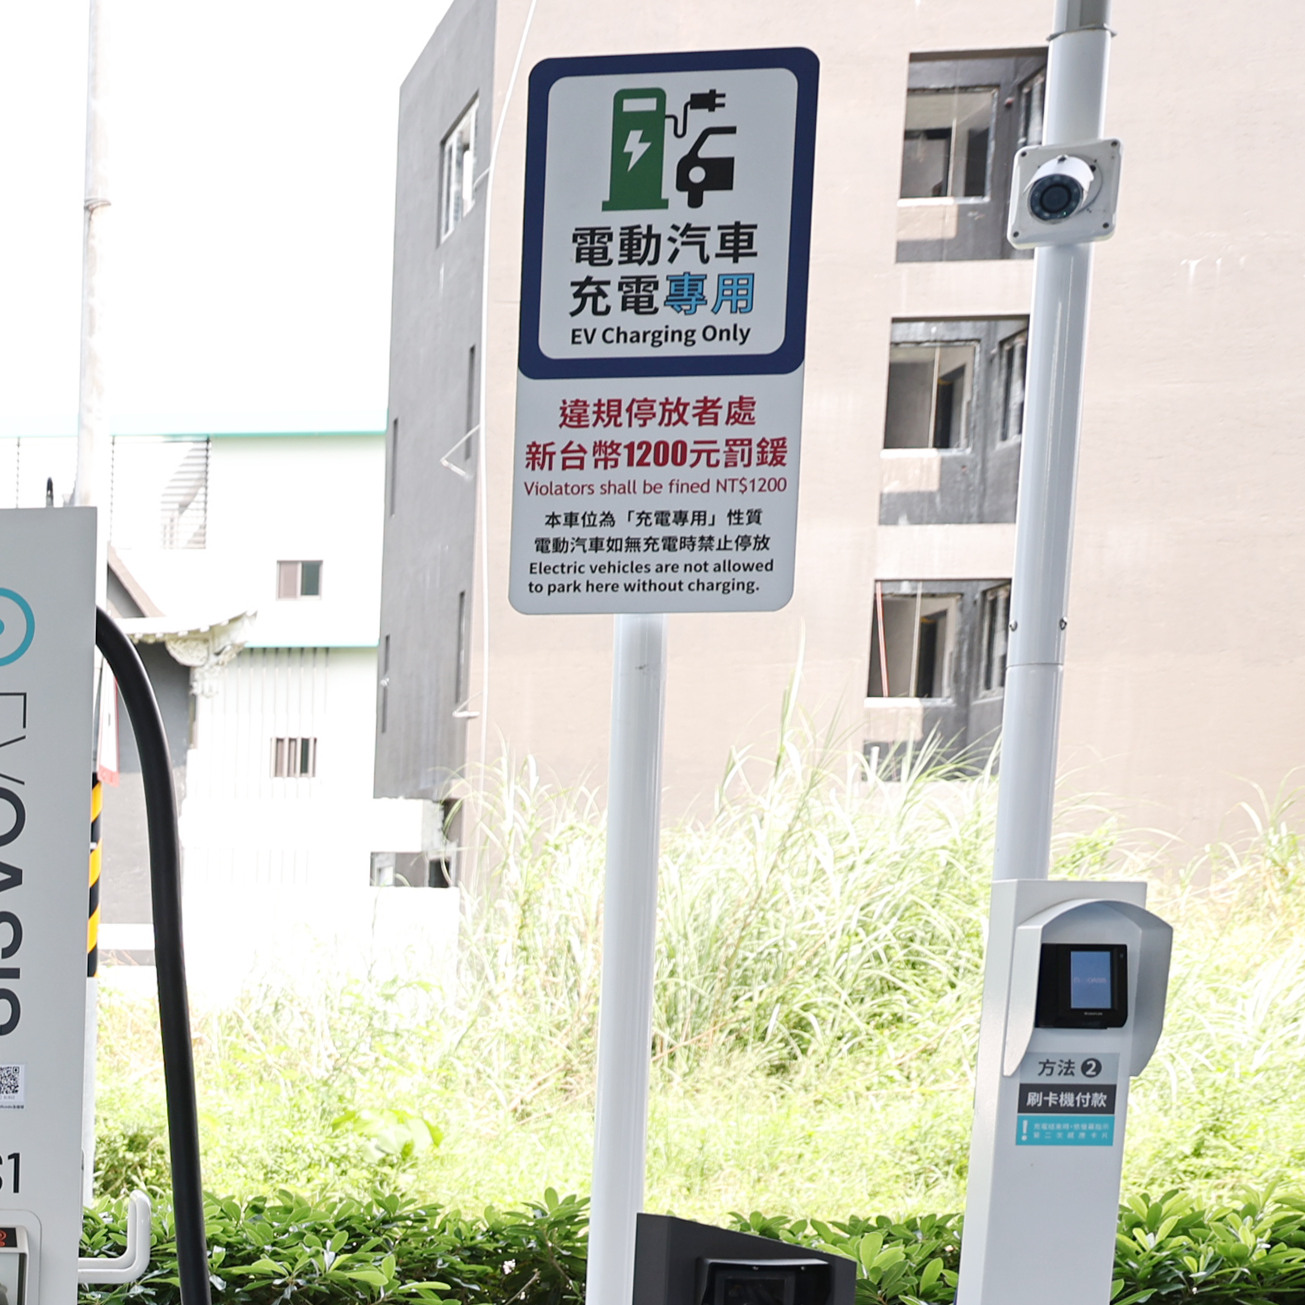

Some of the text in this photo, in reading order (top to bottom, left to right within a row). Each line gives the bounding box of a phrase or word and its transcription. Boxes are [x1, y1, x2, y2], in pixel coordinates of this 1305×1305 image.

[571, 220, 758, 267] 電動汽車
[569, 272, 755, 317] 充電專用
[571, 323, 751, 348] EV Charging Only
[558, 394, 756, 429] 違規停放者處
[525, 436, 787, 471] 新台幣1200元罰鍰
[523, 476, 787, 496] Violators shall be fined NT$1200
[534, 533, 770, 554] 電動汽車如無充電時禁止停放
[529, 558, 773, 574] Electric vehicles are not allowed
[528, 577, 759, 596] to park here without charging.
[1026, 1091, 1107, 1108] 刷卡機付款
